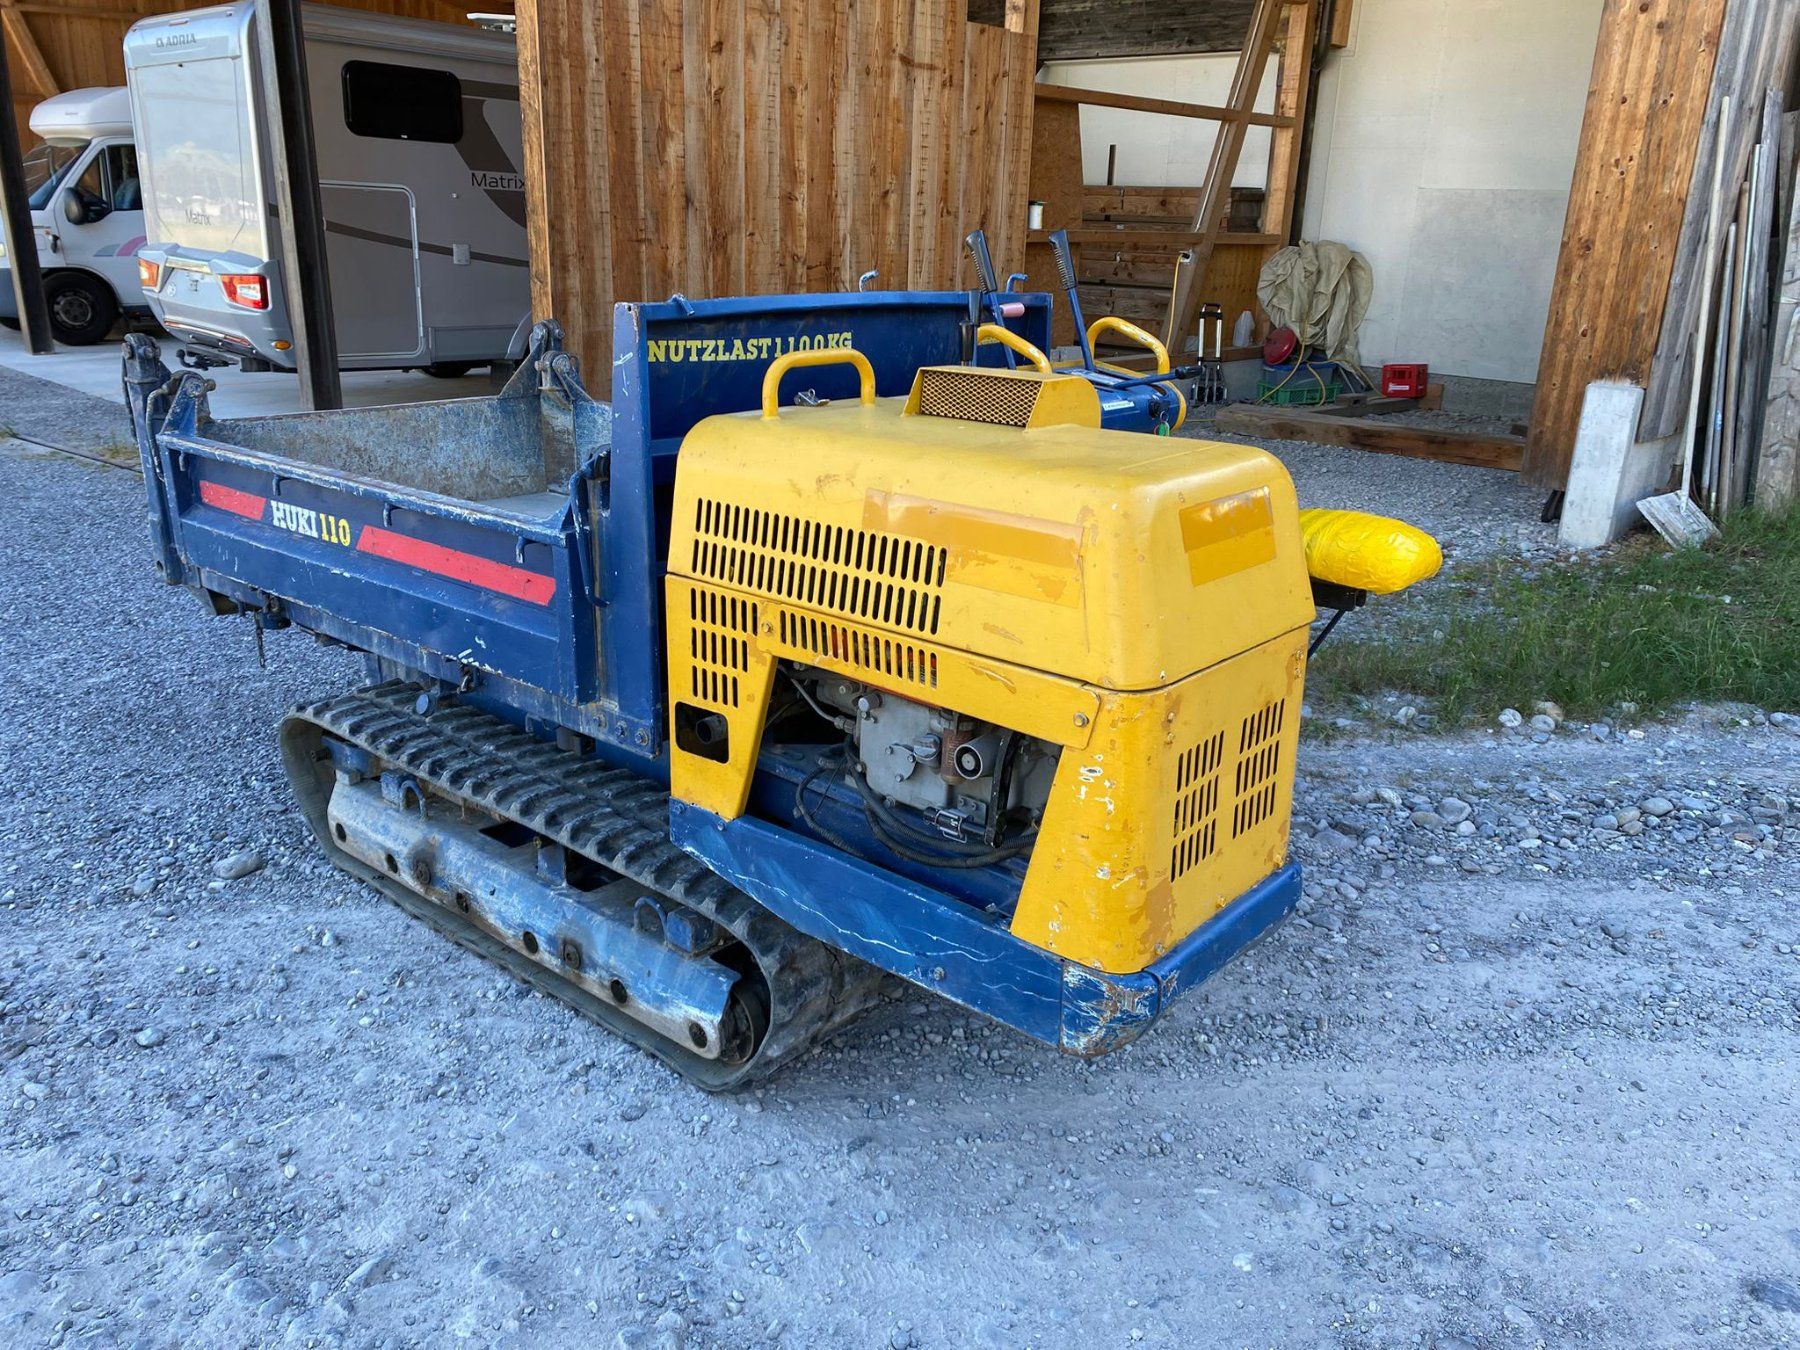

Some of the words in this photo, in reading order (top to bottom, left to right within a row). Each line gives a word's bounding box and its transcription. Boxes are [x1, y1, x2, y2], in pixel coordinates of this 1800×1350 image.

[165, 33, 197, 46] ADRIA
[471, 172, 525, 189] Matrix
[647, 337, 772, 363] NUTZLAST
[271, 500, 318, 539] HUKI
[319, 512, 351, 547] 110
